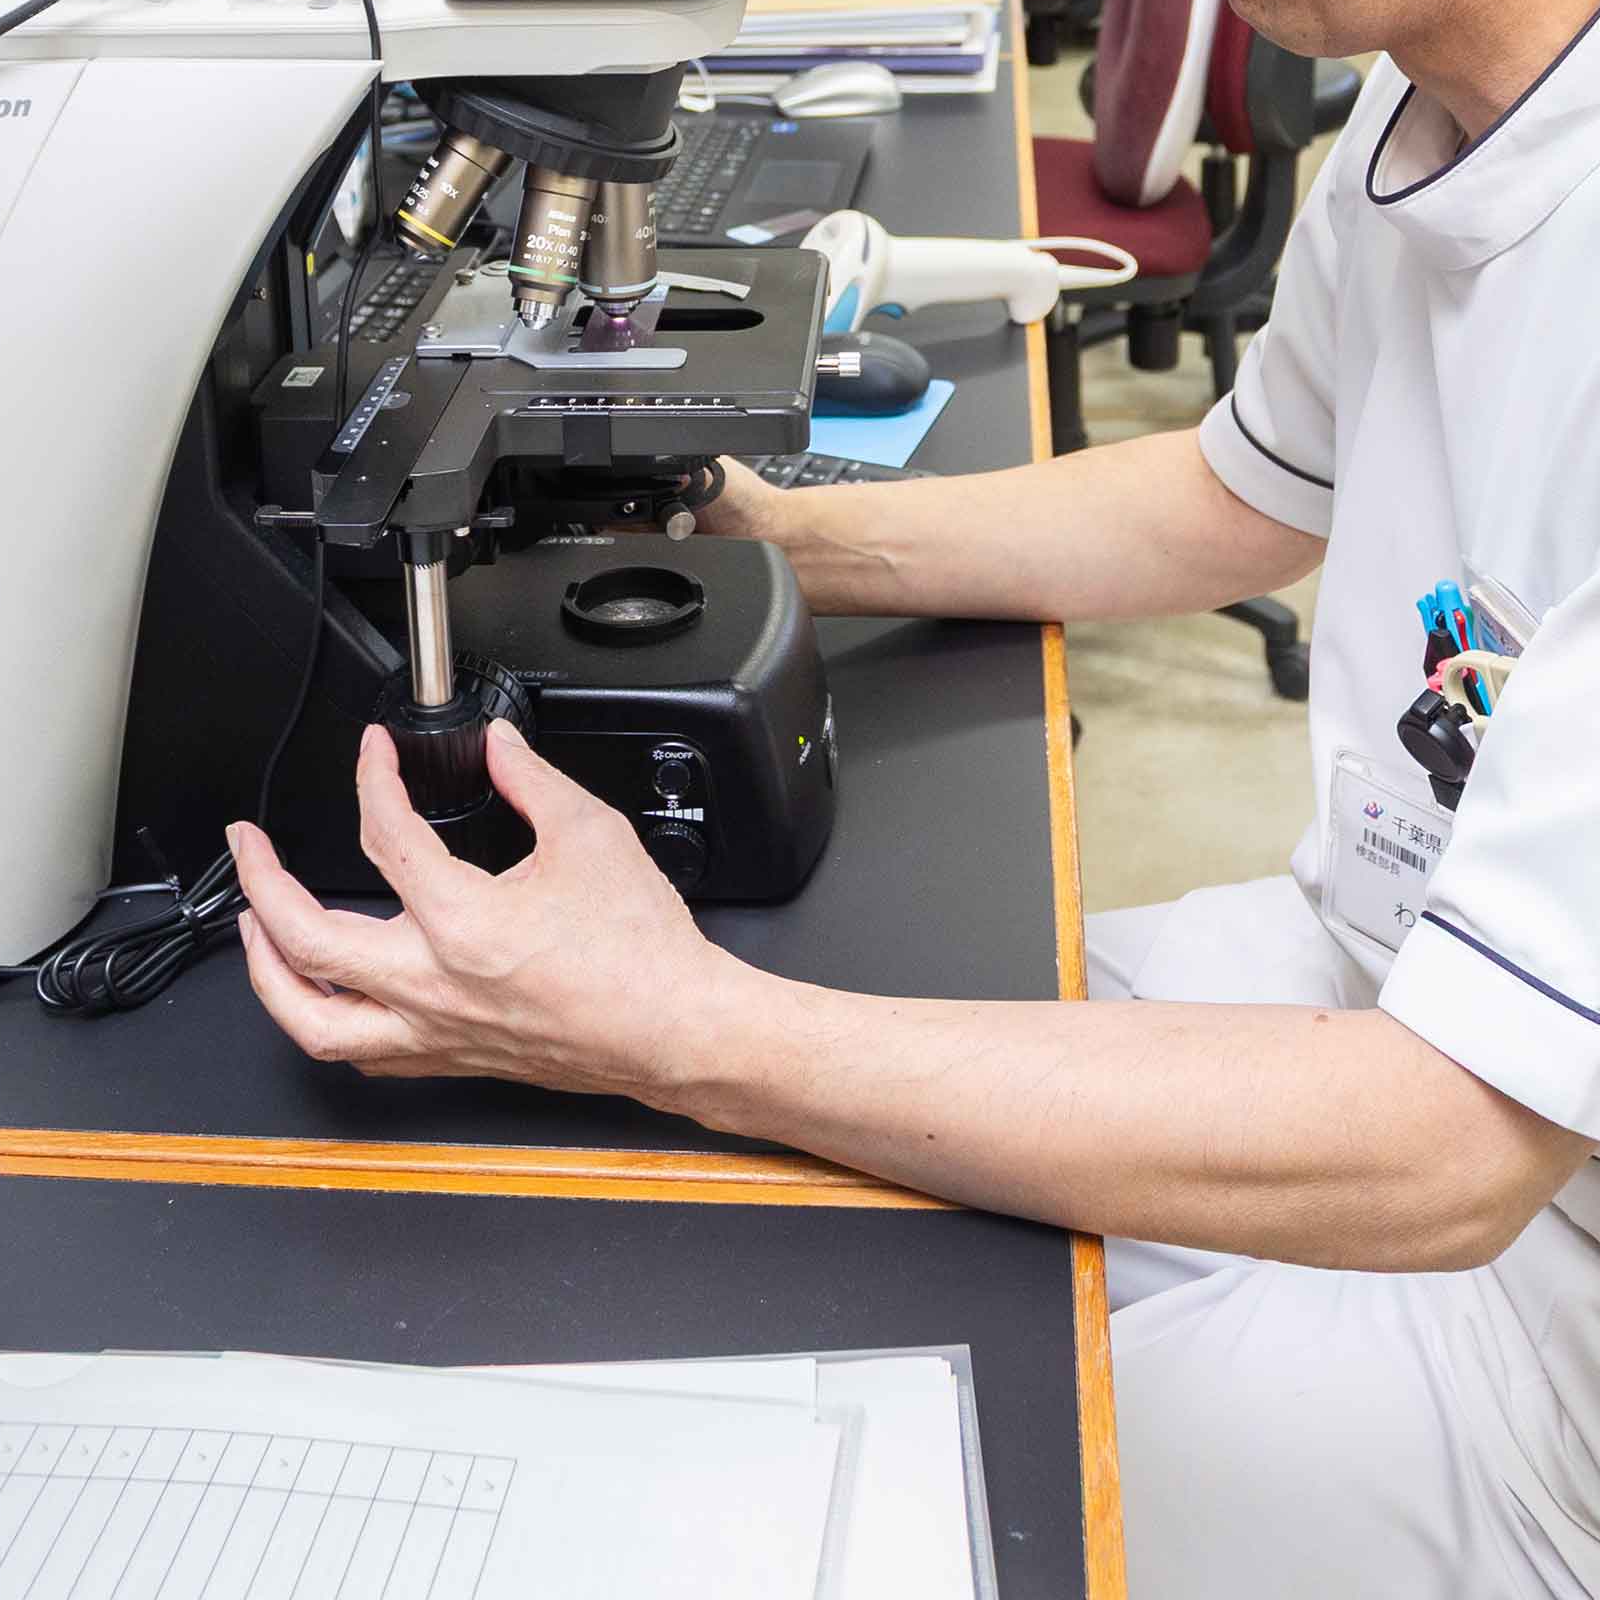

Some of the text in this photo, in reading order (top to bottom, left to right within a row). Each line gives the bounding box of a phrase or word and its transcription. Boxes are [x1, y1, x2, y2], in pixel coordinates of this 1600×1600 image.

[547, 223, 572, 238] Plan
[664, 751, 694, 760] ON/OFF
[1393, 901, 1417, 929] わ
